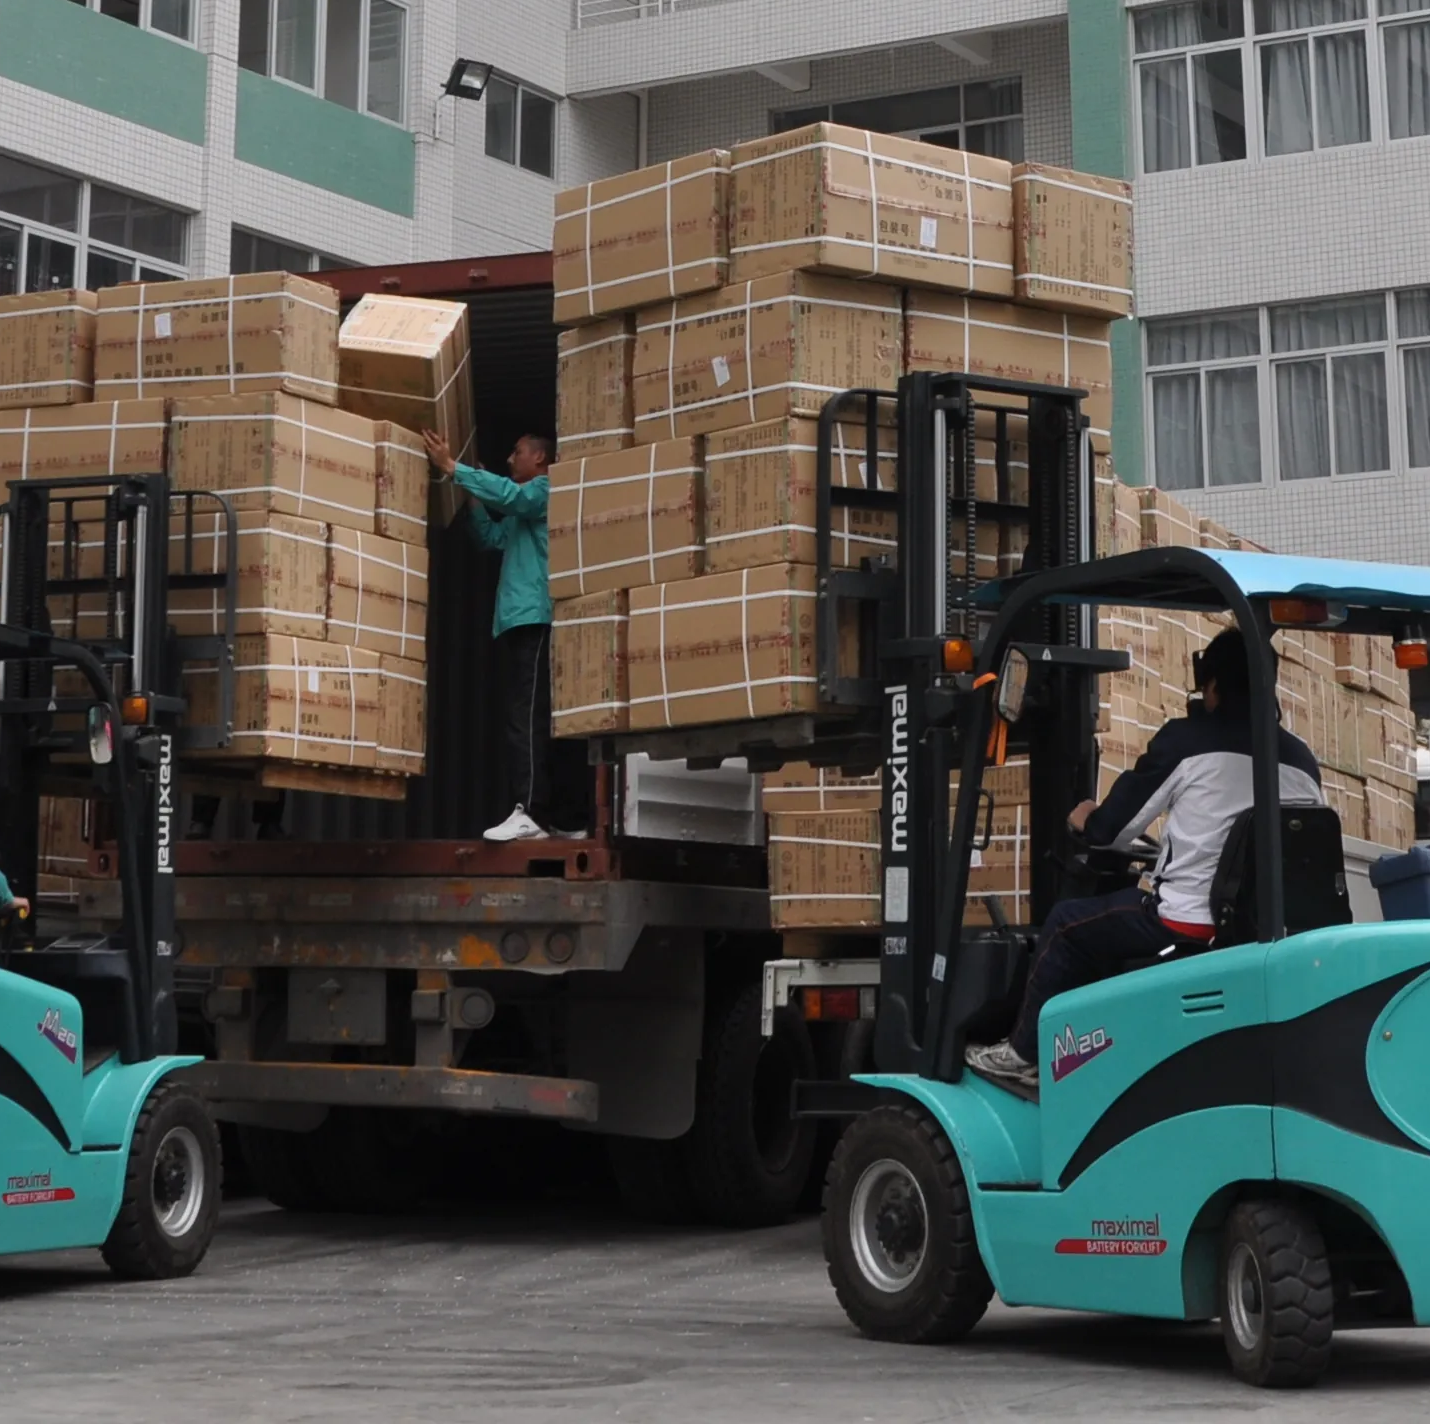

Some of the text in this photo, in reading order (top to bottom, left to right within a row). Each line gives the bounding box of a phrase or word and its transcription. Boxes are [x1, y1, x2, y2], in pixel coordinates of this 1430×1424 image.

[884, 684, 908, 853] maximal
[157, 734, 174, 874] maximal
[40, 1008, 77, 1049] M20
[1053, 1024, 1107, 1073] M20
[7, 1168, 51, 1190] maximal
[1091, 1212, 1159, 1237] maximal
[1086, 1240, 1161, 1254] BATTERY FORKLIFT
